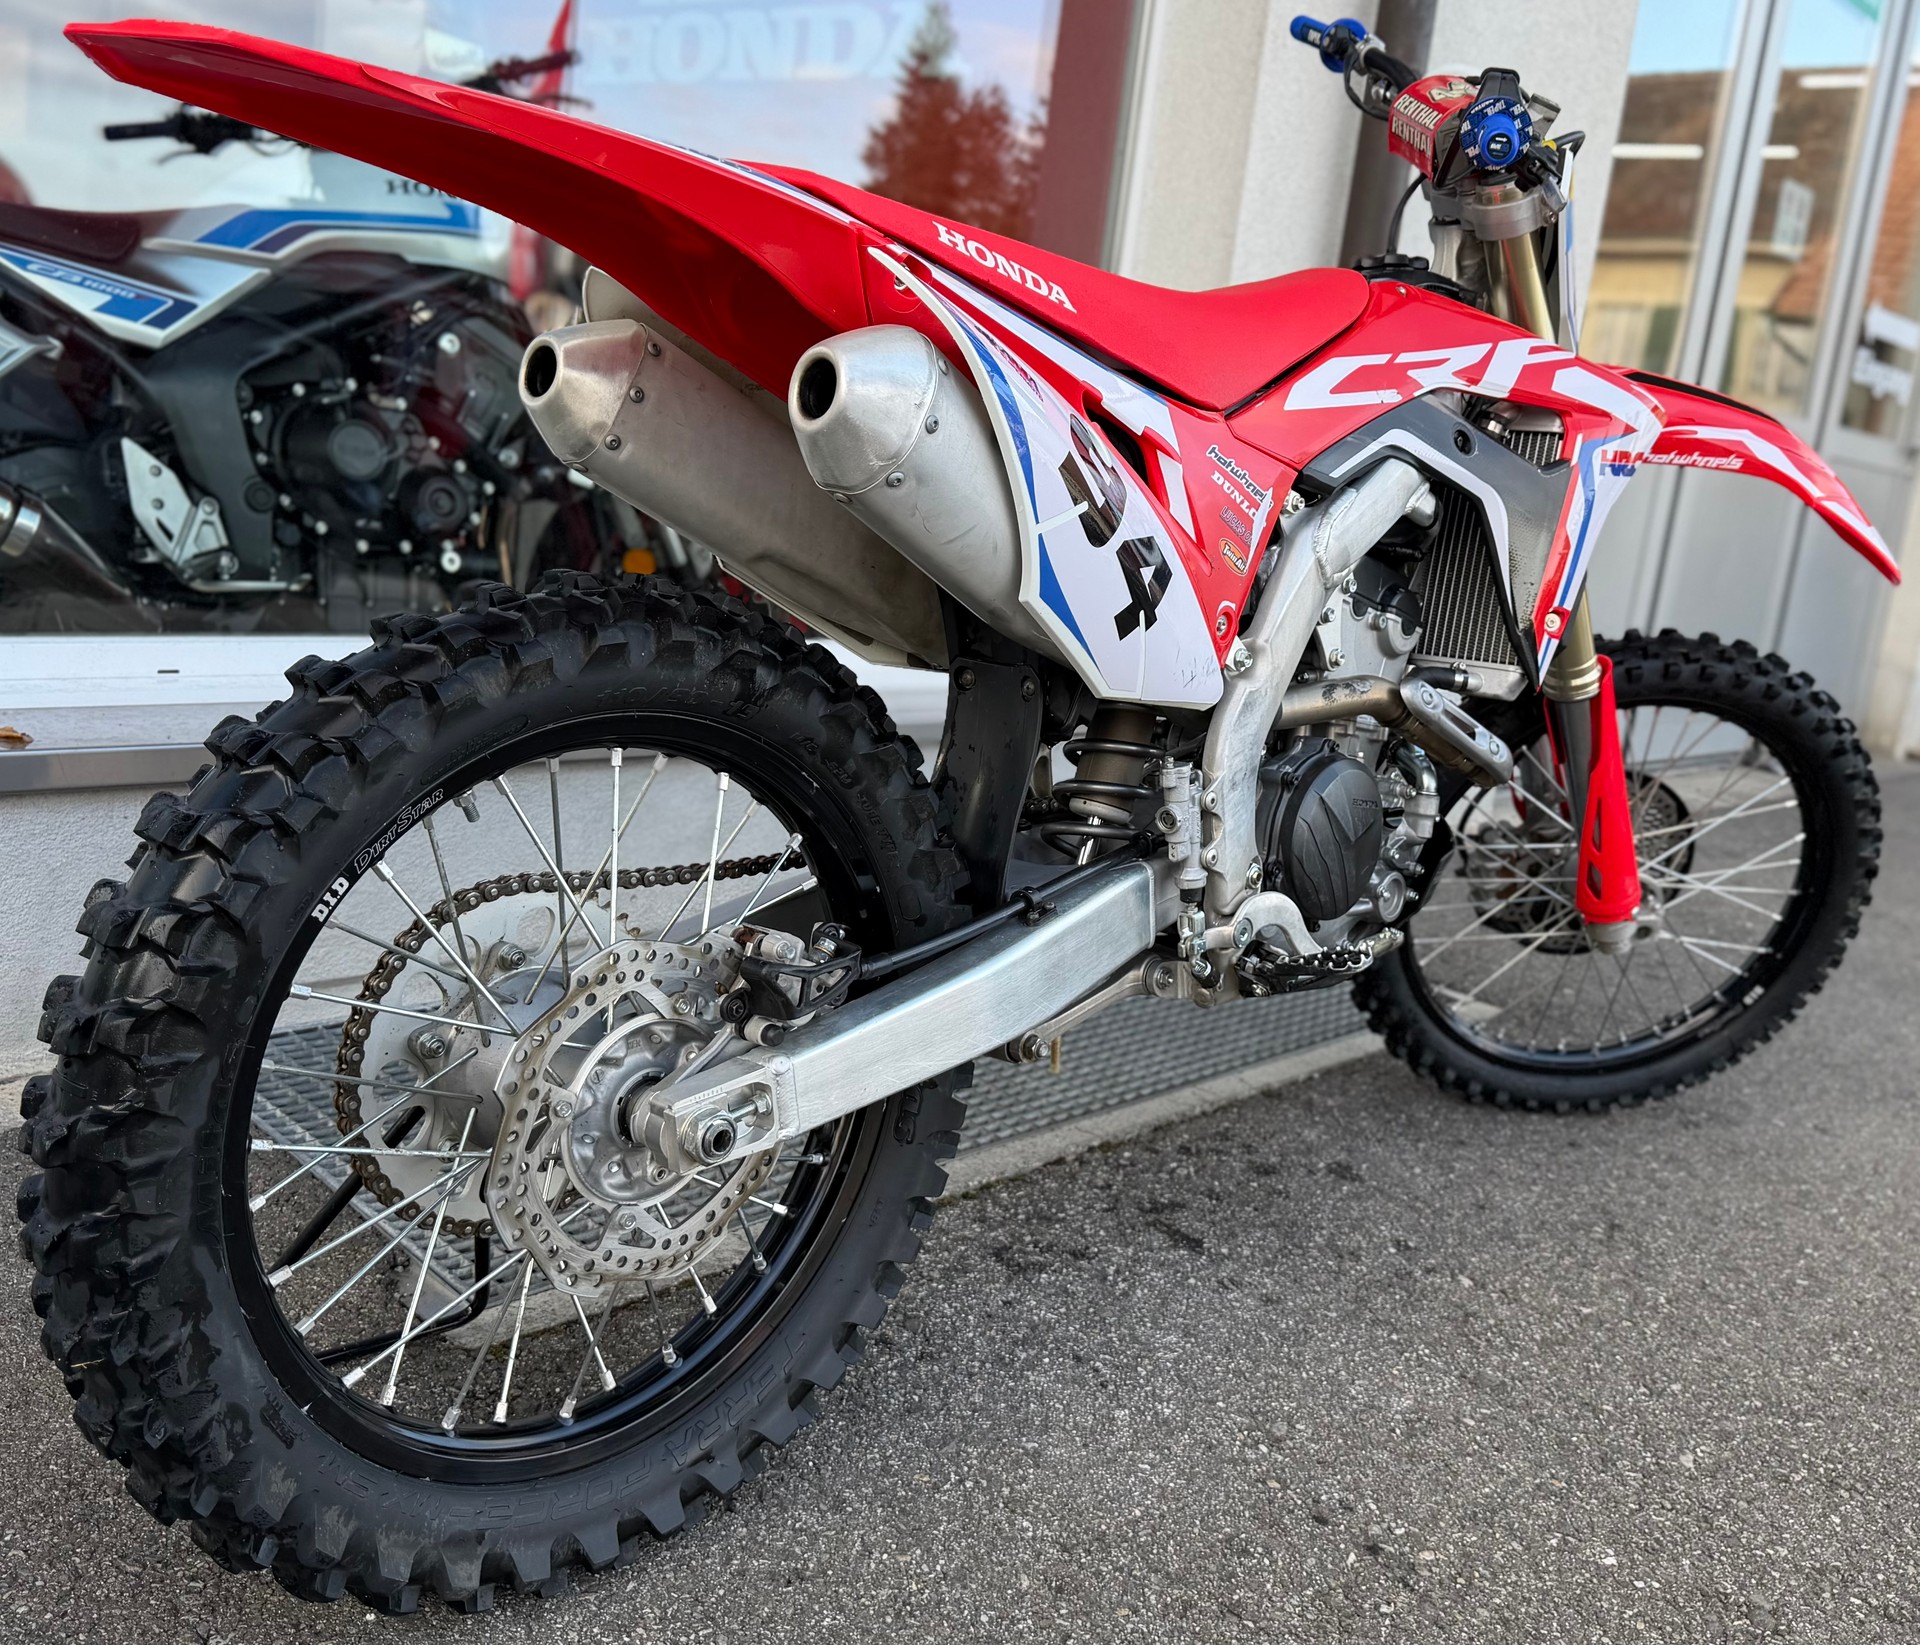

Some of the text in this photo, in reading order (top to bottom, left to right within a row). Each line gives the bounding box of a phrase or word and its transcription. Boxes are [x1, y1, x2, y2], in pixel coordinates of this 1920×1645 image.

[1393, 94, 1444, 131] RENTHAL
[1391, 116, 1432, 159] RENTHAL
[932, 220, 1078, 314] HONDA
[1211, 470, 1264, 525] DUNLO
[311, 876, 350, 923] D.I.D
